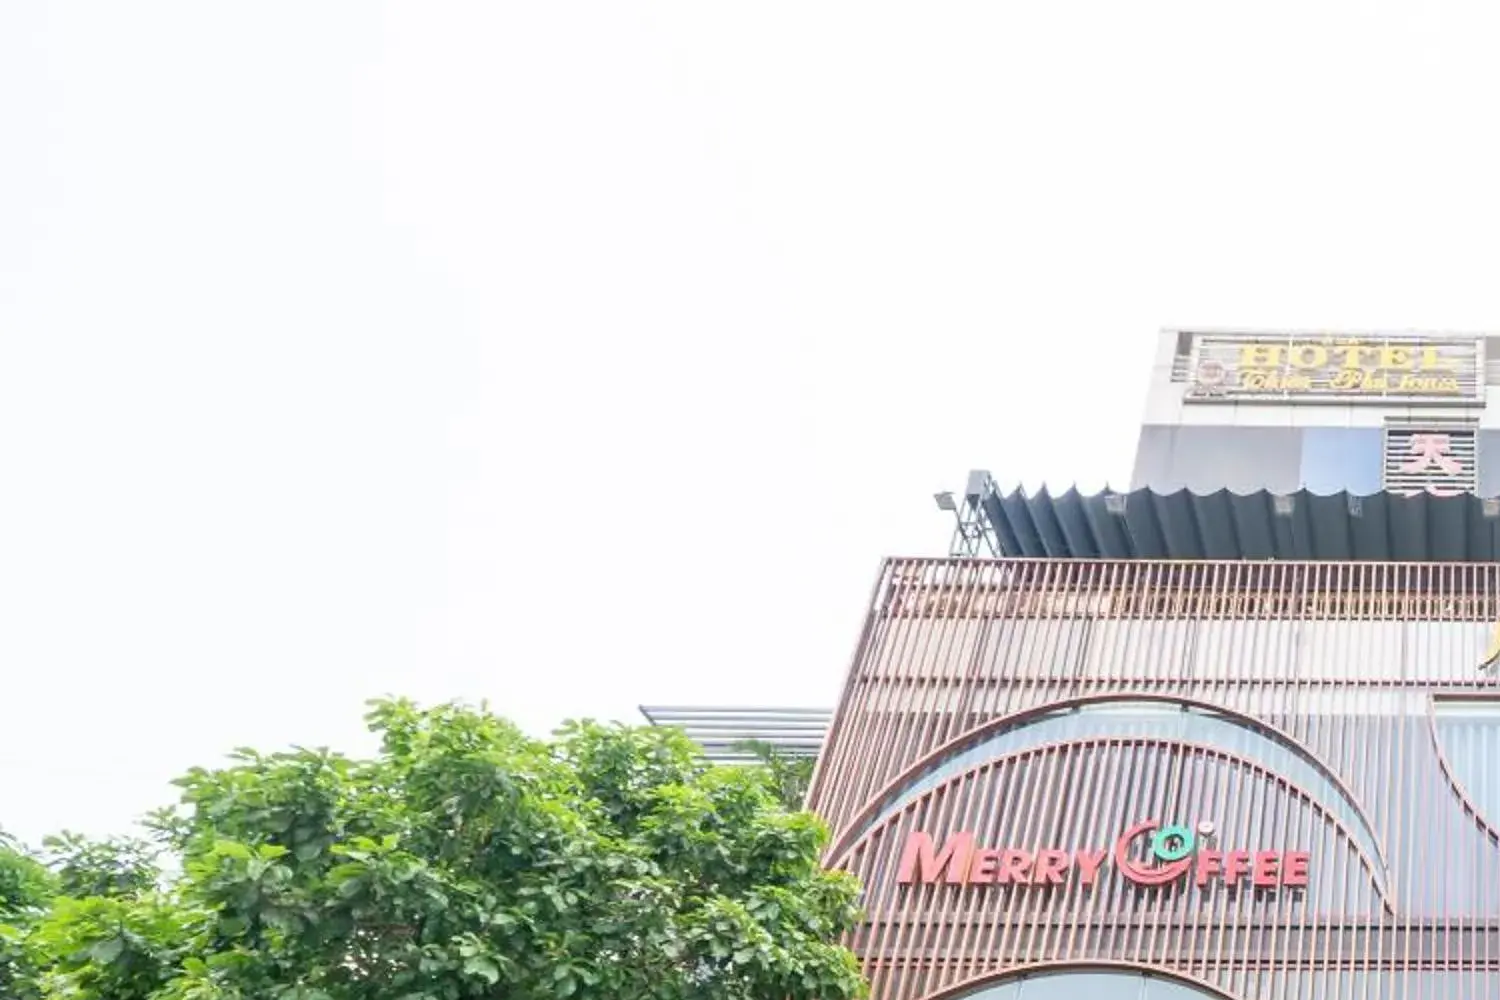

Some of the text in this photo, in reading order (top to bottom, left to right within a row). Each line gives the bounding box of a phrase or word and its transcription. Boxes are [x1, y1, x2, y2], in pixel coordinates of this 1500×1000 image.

[1238, 344, 1460, 370] HOTEL
[1399, 431, 1464, 497] 天
[897, 817, 1312, 888] MERRY COFFEE
